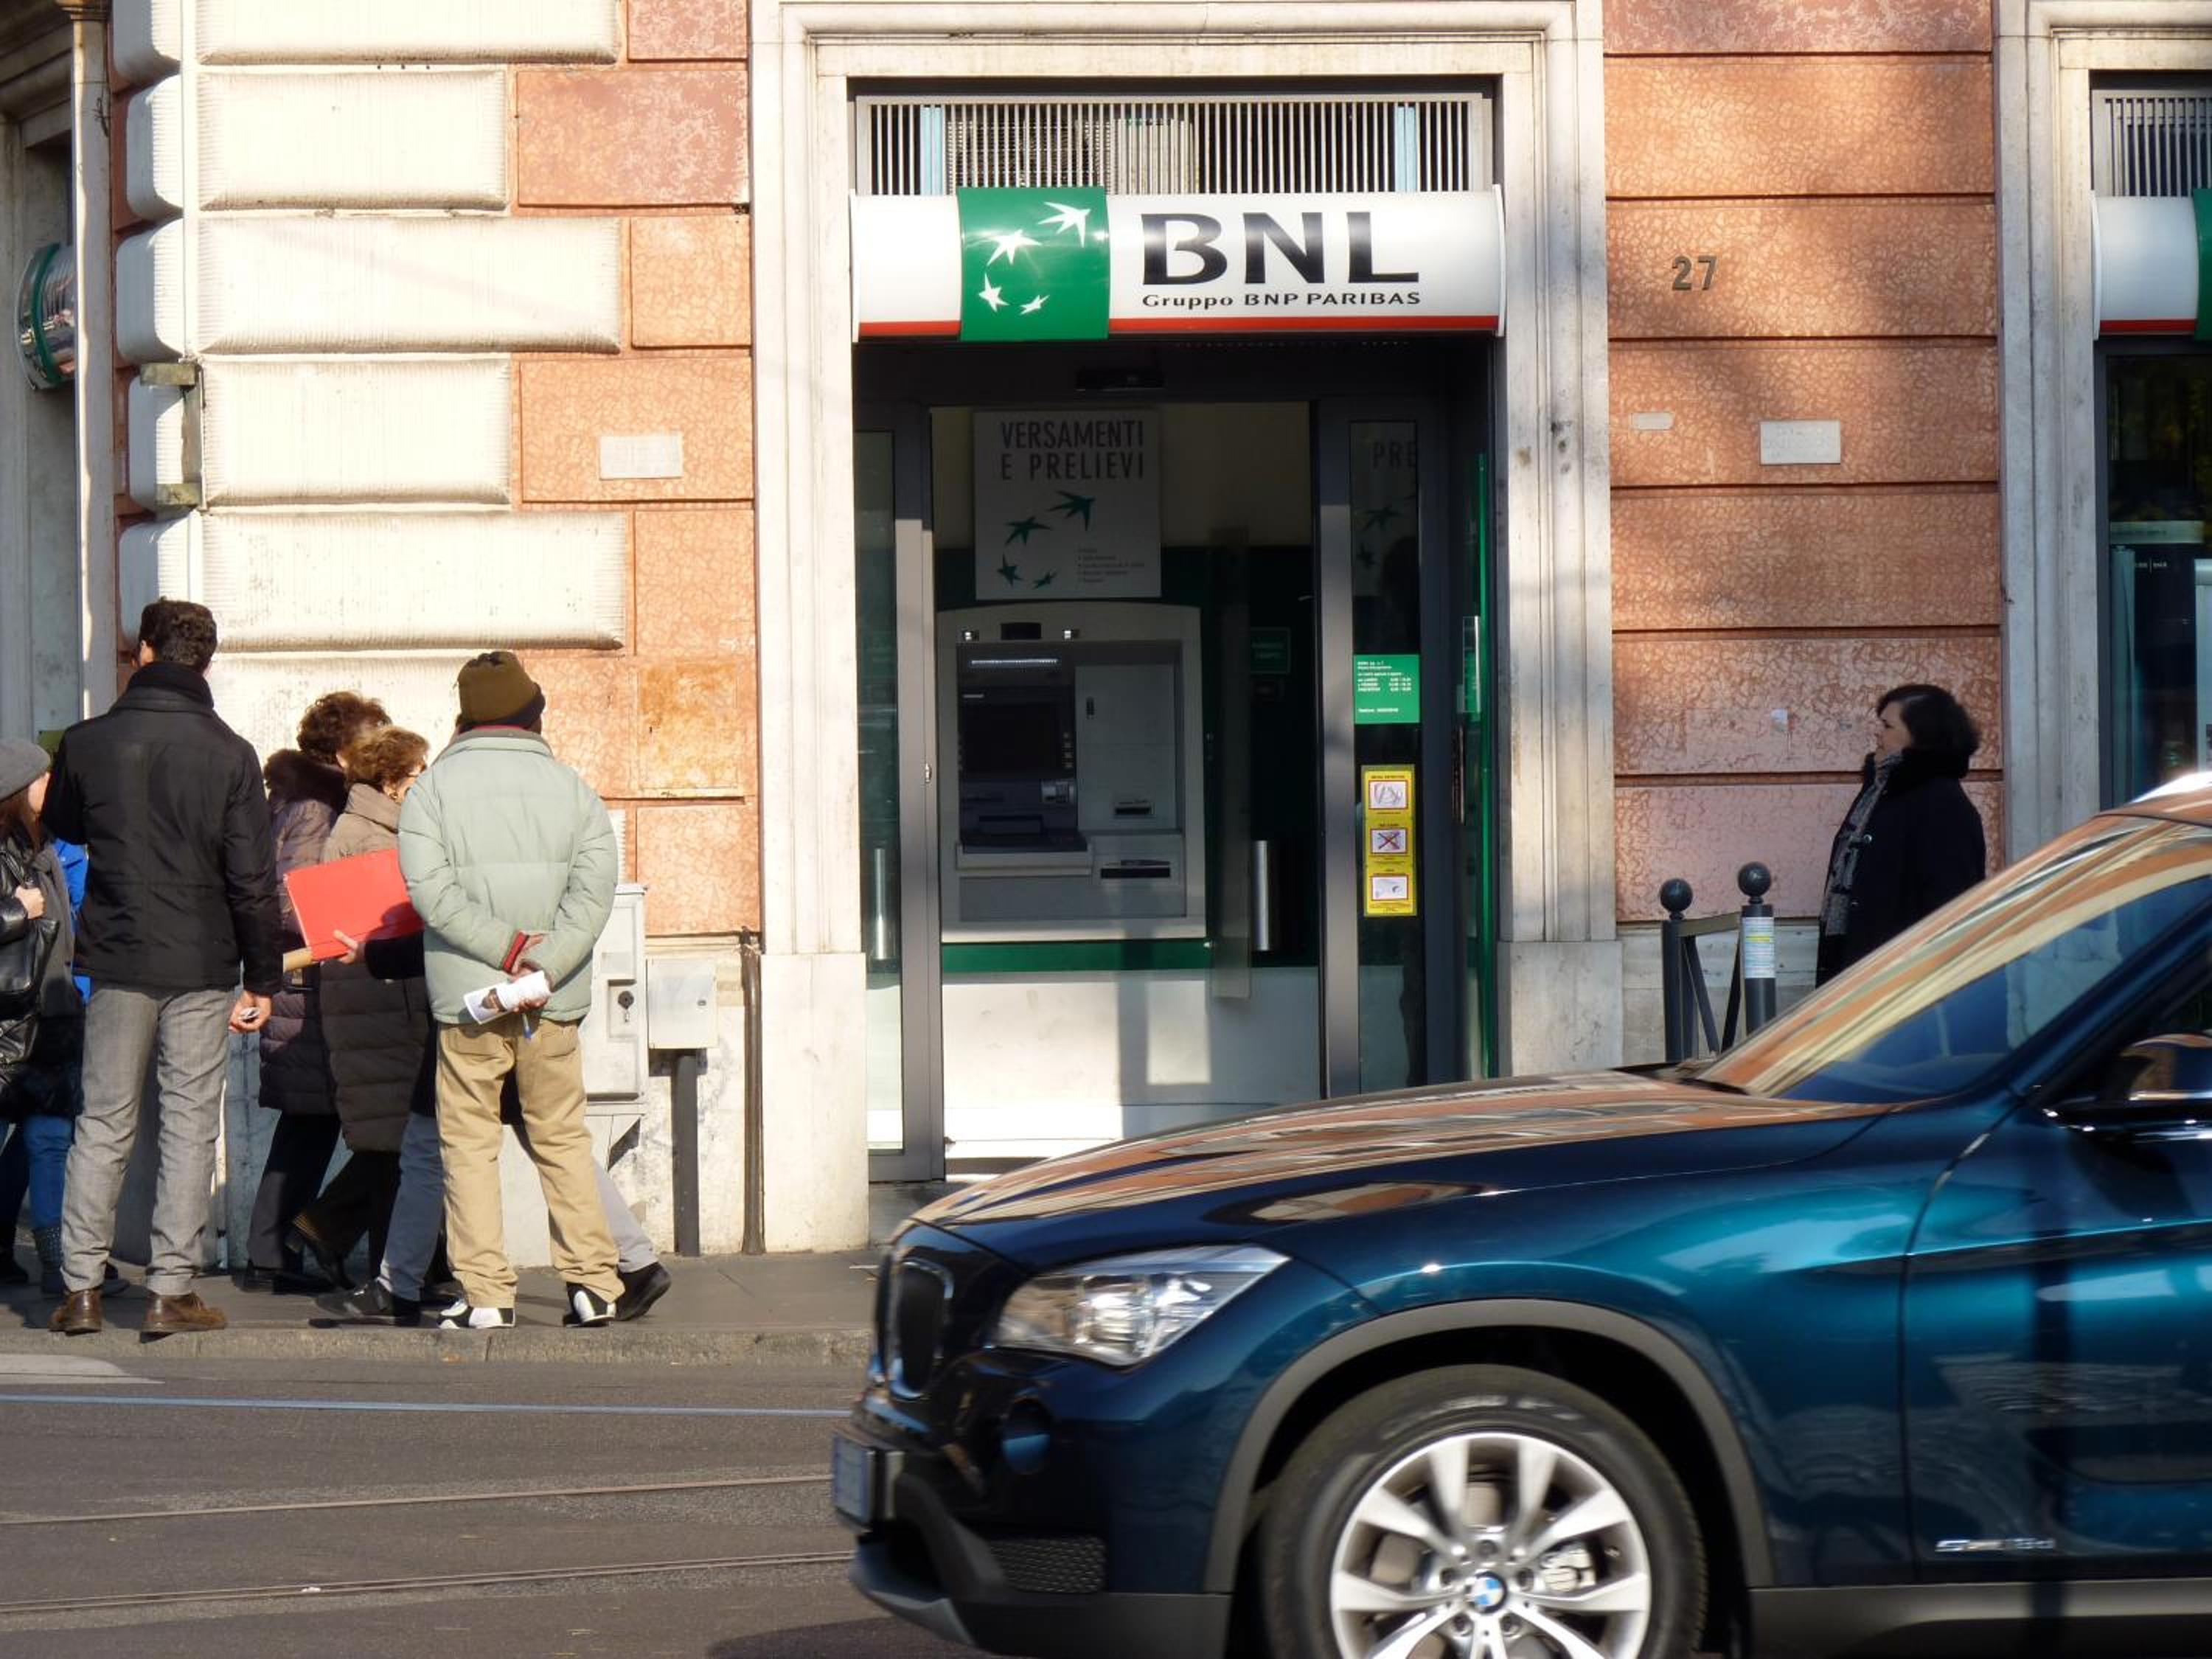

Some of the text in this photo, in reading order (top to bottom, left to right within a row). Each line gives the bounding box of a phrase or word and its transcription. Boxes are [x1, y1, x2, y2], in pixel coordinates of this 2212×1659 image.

[1141, 212, 1419, 285] BNL
[1672, 256, 1717, 291] 27
[1142, 292, 1420, 310] Gruppo BNP PARIBAS
[1000, 420, 1143, 449] VERSAMENTI
[1001, 451, 1143, 481] E PRELIEVI
